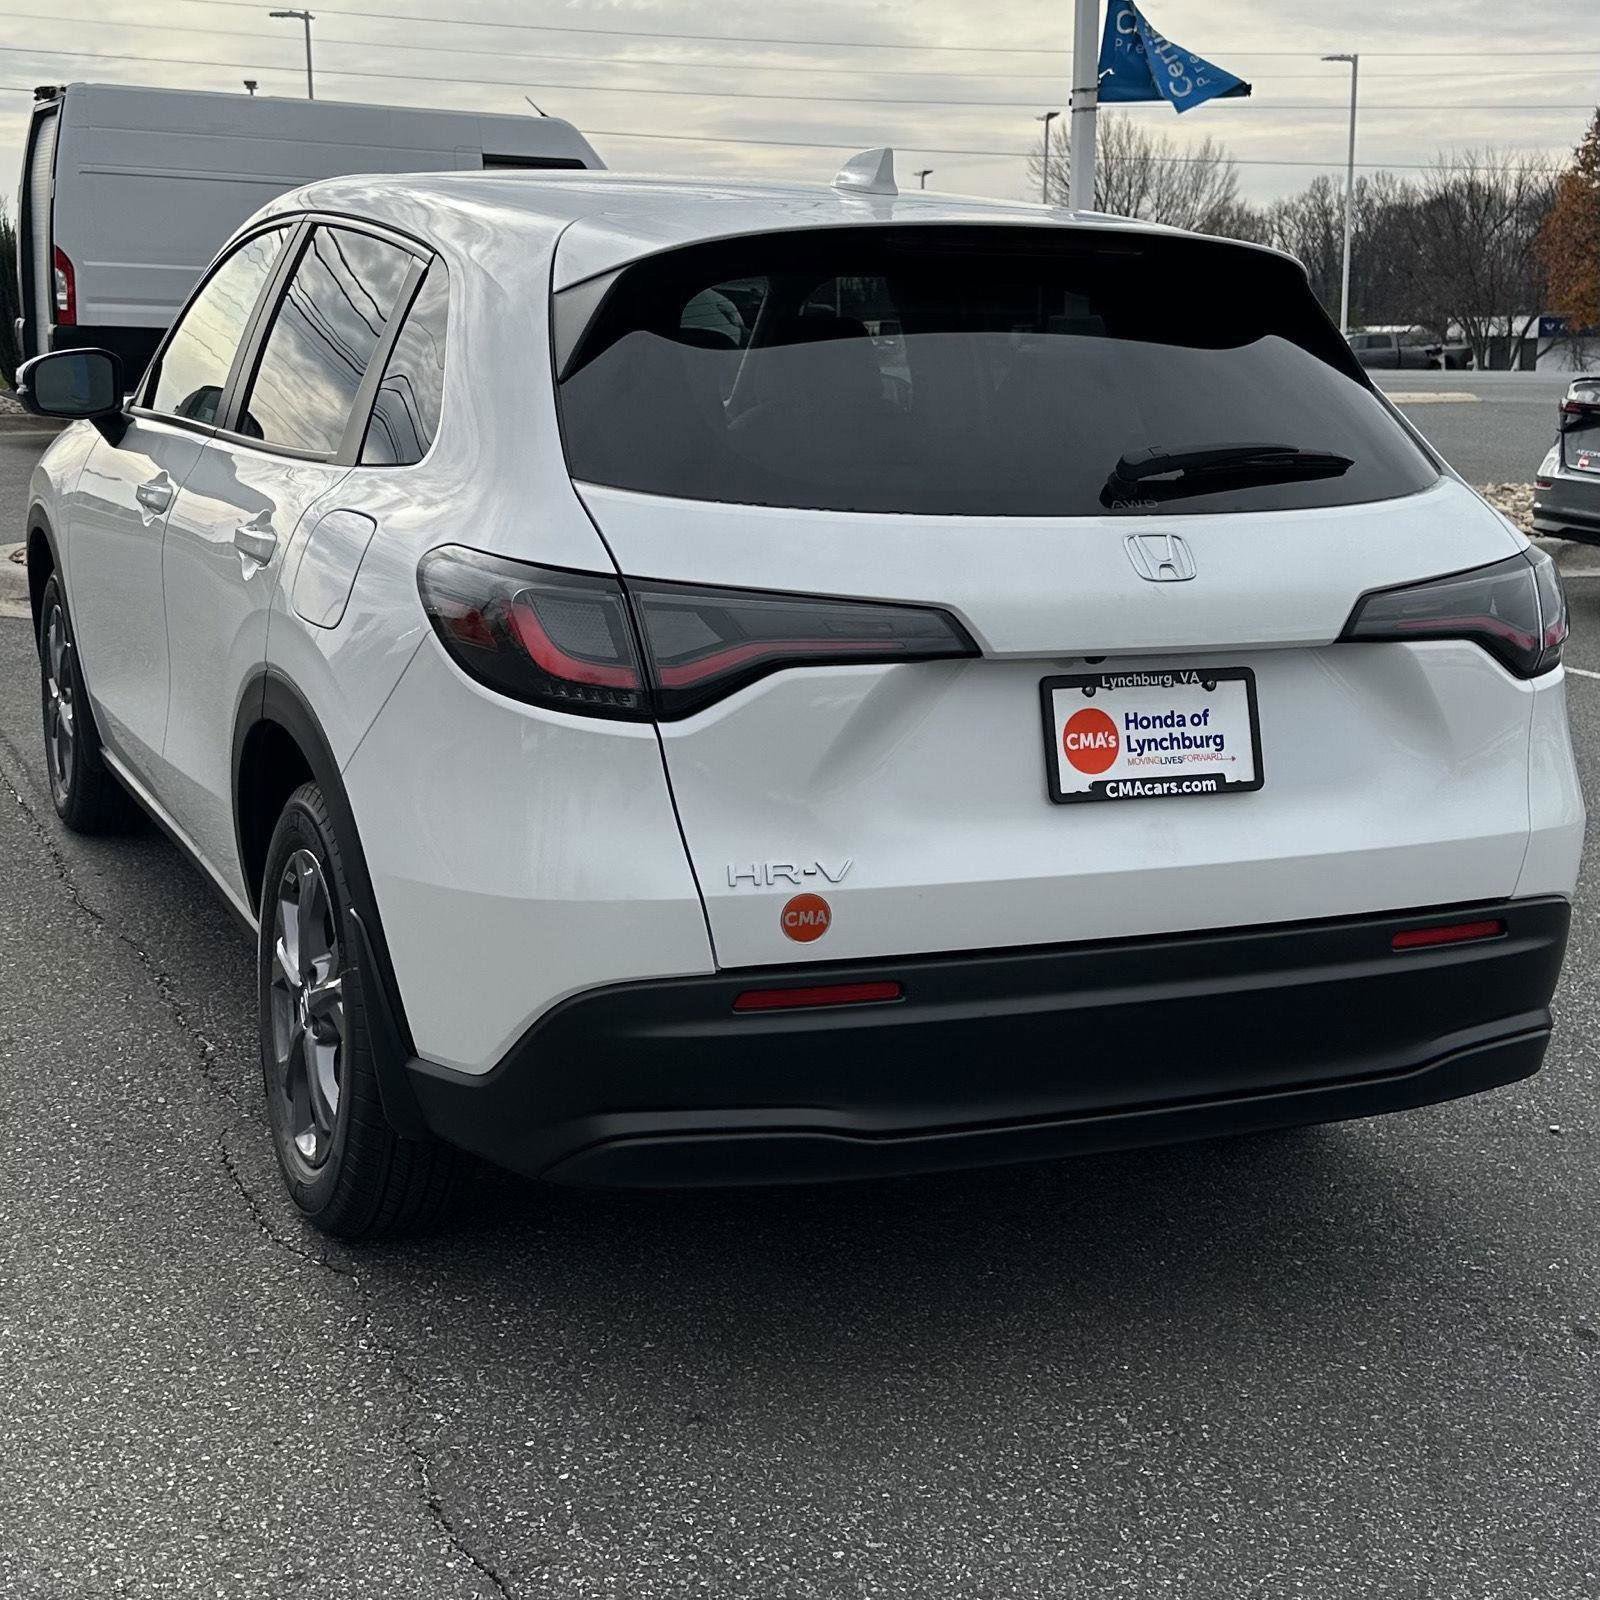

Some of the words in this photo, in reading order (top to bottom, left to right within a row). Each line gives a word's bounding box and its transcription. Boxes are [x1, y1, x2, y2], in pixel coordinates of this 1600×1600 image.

[1180, 671, 1200, 684] VA
[1124, 710, 1187, 731] Honda
[1190, 708, 1210, 727] of
[1066, 731, 1117, 751] CMA's
[1126, 732, 1225, 757] Lynchburg
[1105, 778, 1218, 799] CMAcars.com
[726, 857, 854, 888] HR-V
[784, 909, 828, 927] CMA
